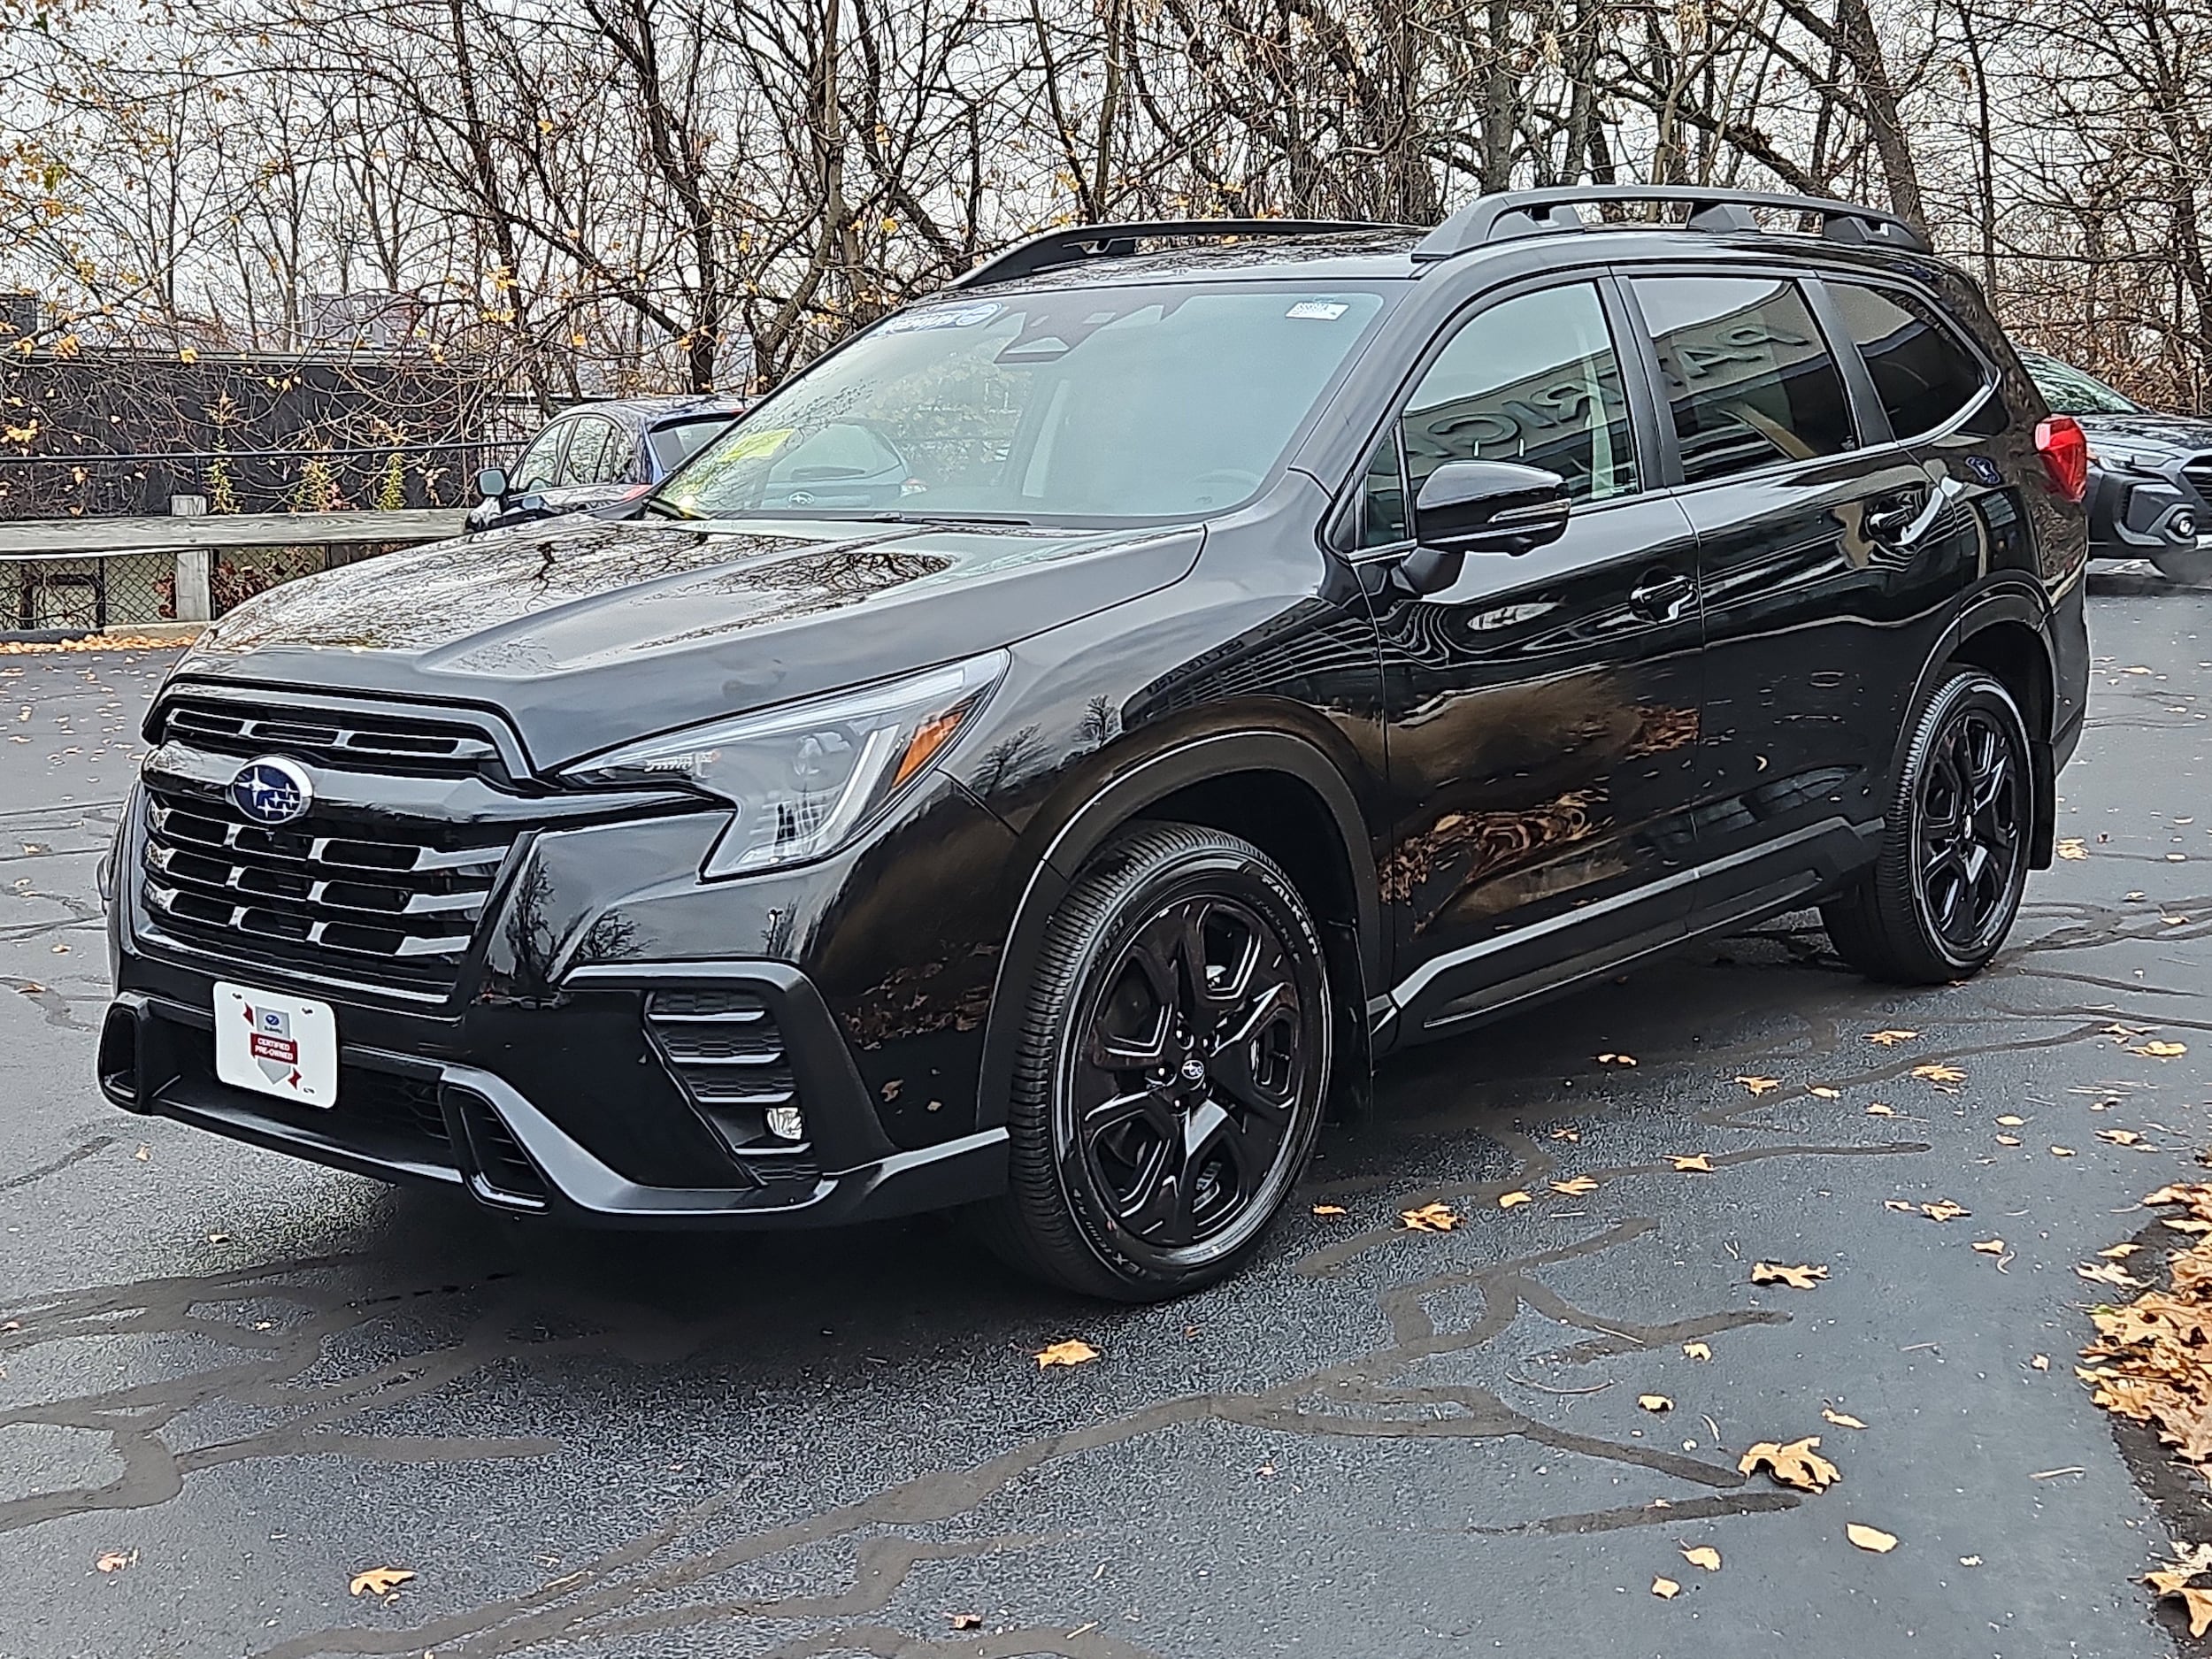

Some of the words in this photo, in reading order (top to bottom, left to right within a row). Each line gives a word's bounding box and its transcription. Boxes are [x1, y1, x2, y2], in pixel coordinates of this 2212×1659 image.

[1261, 873, 1318, 955] FALKEN
[257, 1037, 290, 1051] CERTIFIED
[255, 1045, 293, 1060] PRE-OWNED
